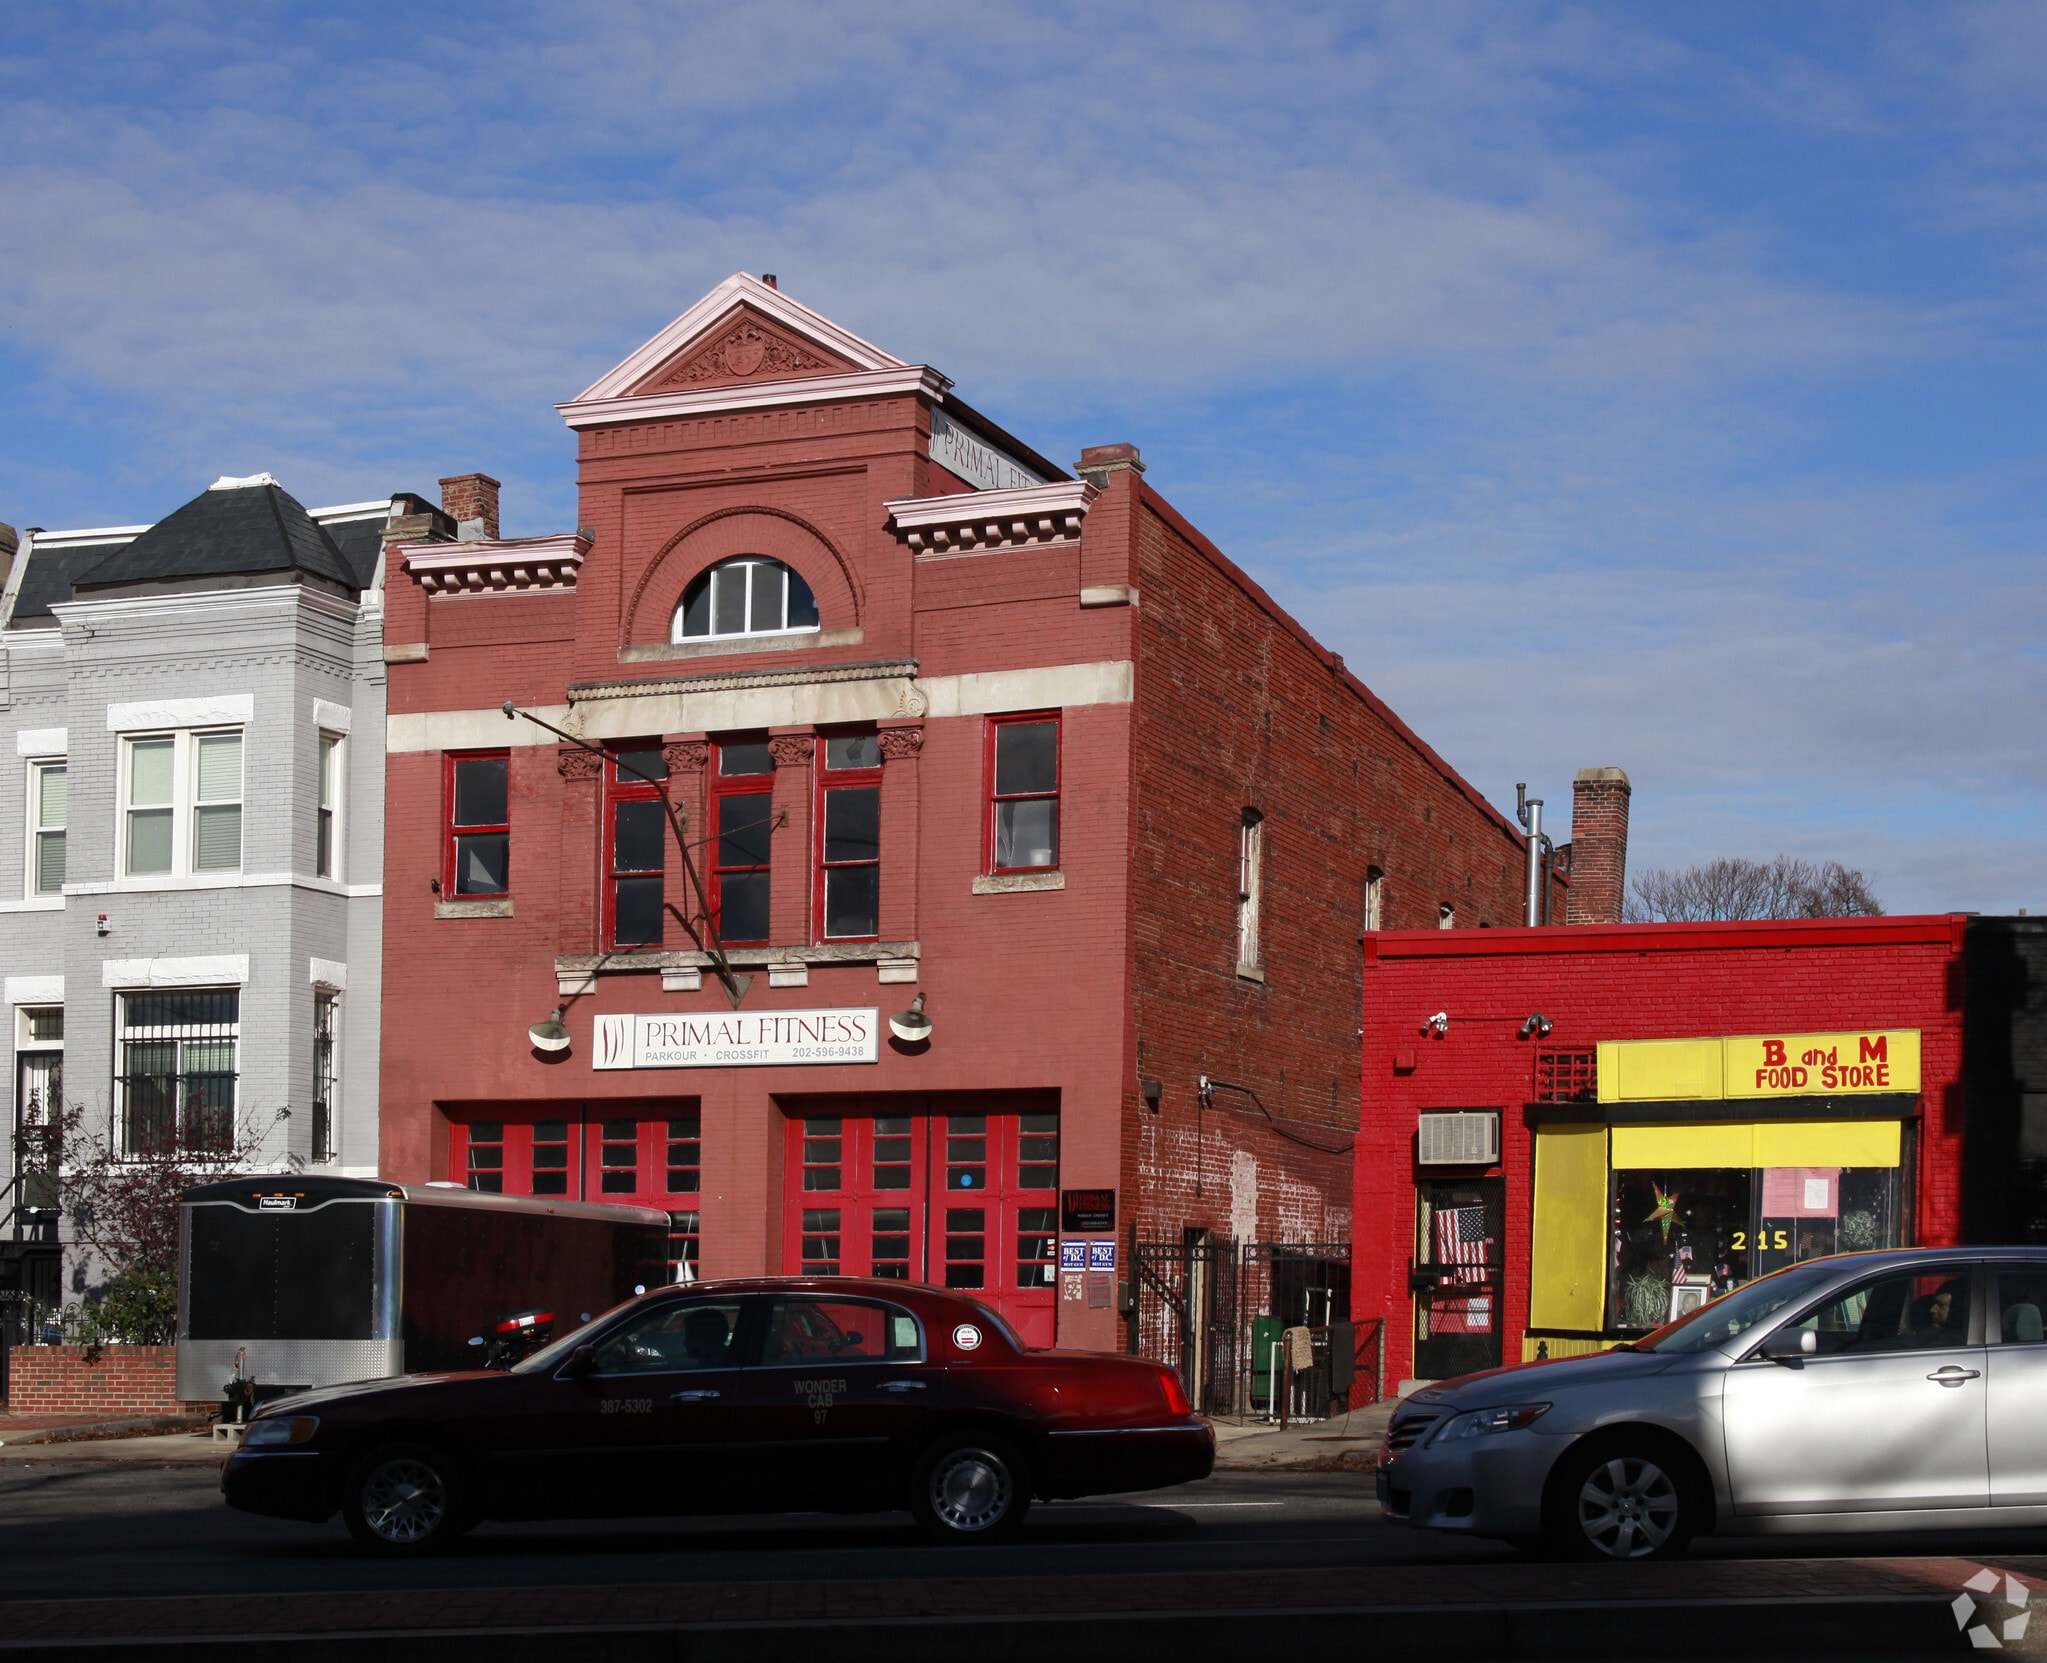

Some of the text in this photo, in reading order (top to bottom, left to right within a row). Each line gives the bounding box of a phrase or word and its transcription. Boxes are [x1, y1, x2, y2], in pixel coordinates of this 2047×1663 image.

[944, 423, 1033, 488] PRIMAL FIT
[646, 1015, 866, 1047] PRIMAL FITNESS
[645, 1046, 864, 1061] PARKOUR CROSSFIT 202-596-9438
[1762, 1035, 1887, 1066] B and M
[1756, 1064, 1890, 1089] FOOD STORE
[1080, 1202, 1110, 1210] FITNESS
[1063, 1247, 1084, 1255] BEST
[1092, 1247, 1113, 1255] BEST
[793, 1379, 847, 1394] WONDER
[600, 1399, 652, 1414] 387-5302
[808, 1394, 833, 1409] CAB
[814, 1410, 828, 1425] 97
